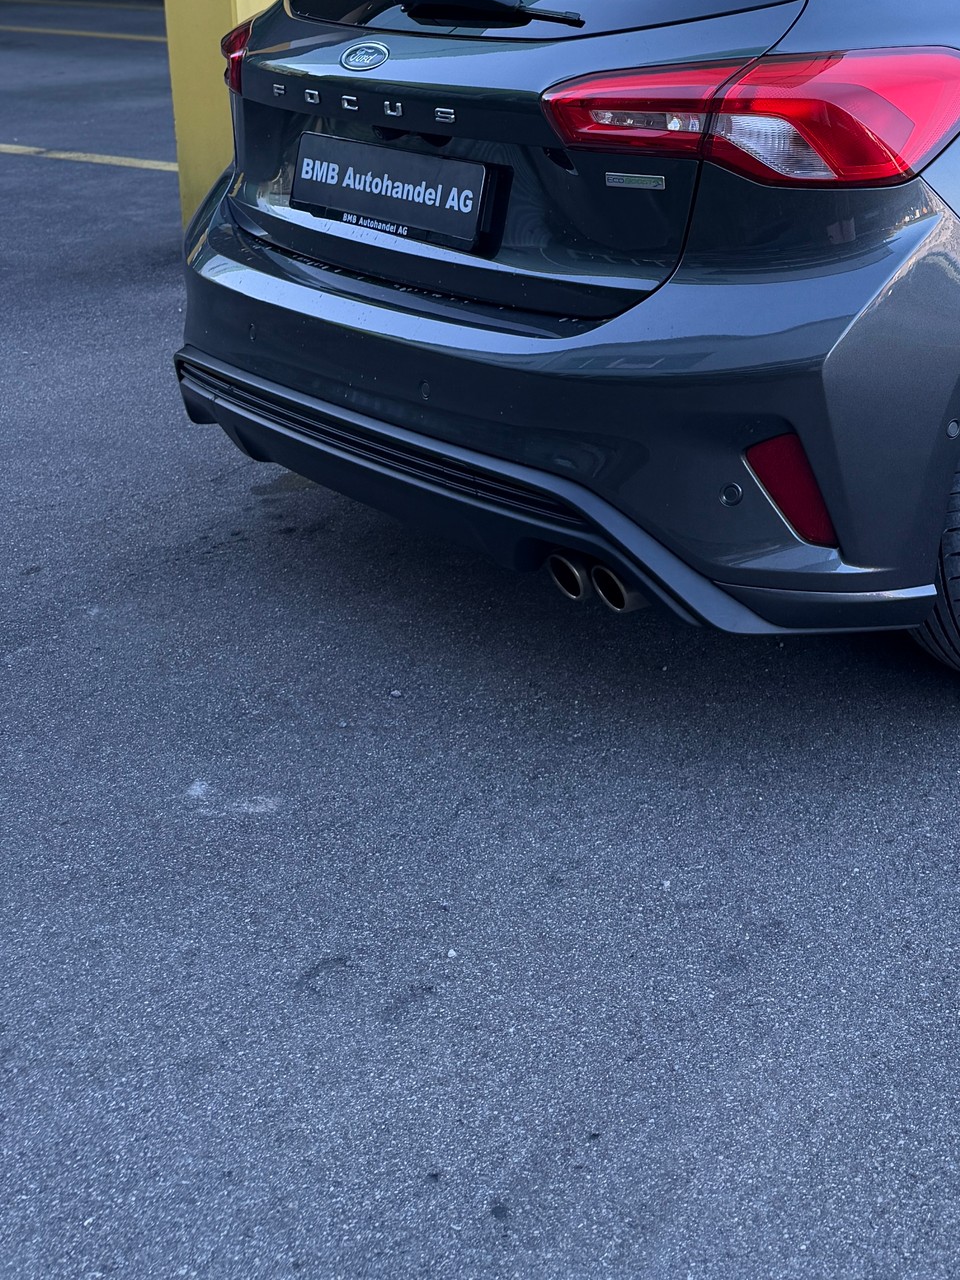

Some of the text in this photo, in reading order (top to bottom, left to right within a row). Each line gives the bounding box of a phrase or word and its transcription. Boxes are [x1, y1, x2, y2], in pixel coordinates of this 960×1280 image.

[349, 47, 377, 64] Ford
[272, 83, 455, 123] FOCUS
[301, 157, 474, 213] BMB Autohandel AG
[342, 212, 409, 236] BMB Autohandel AG
